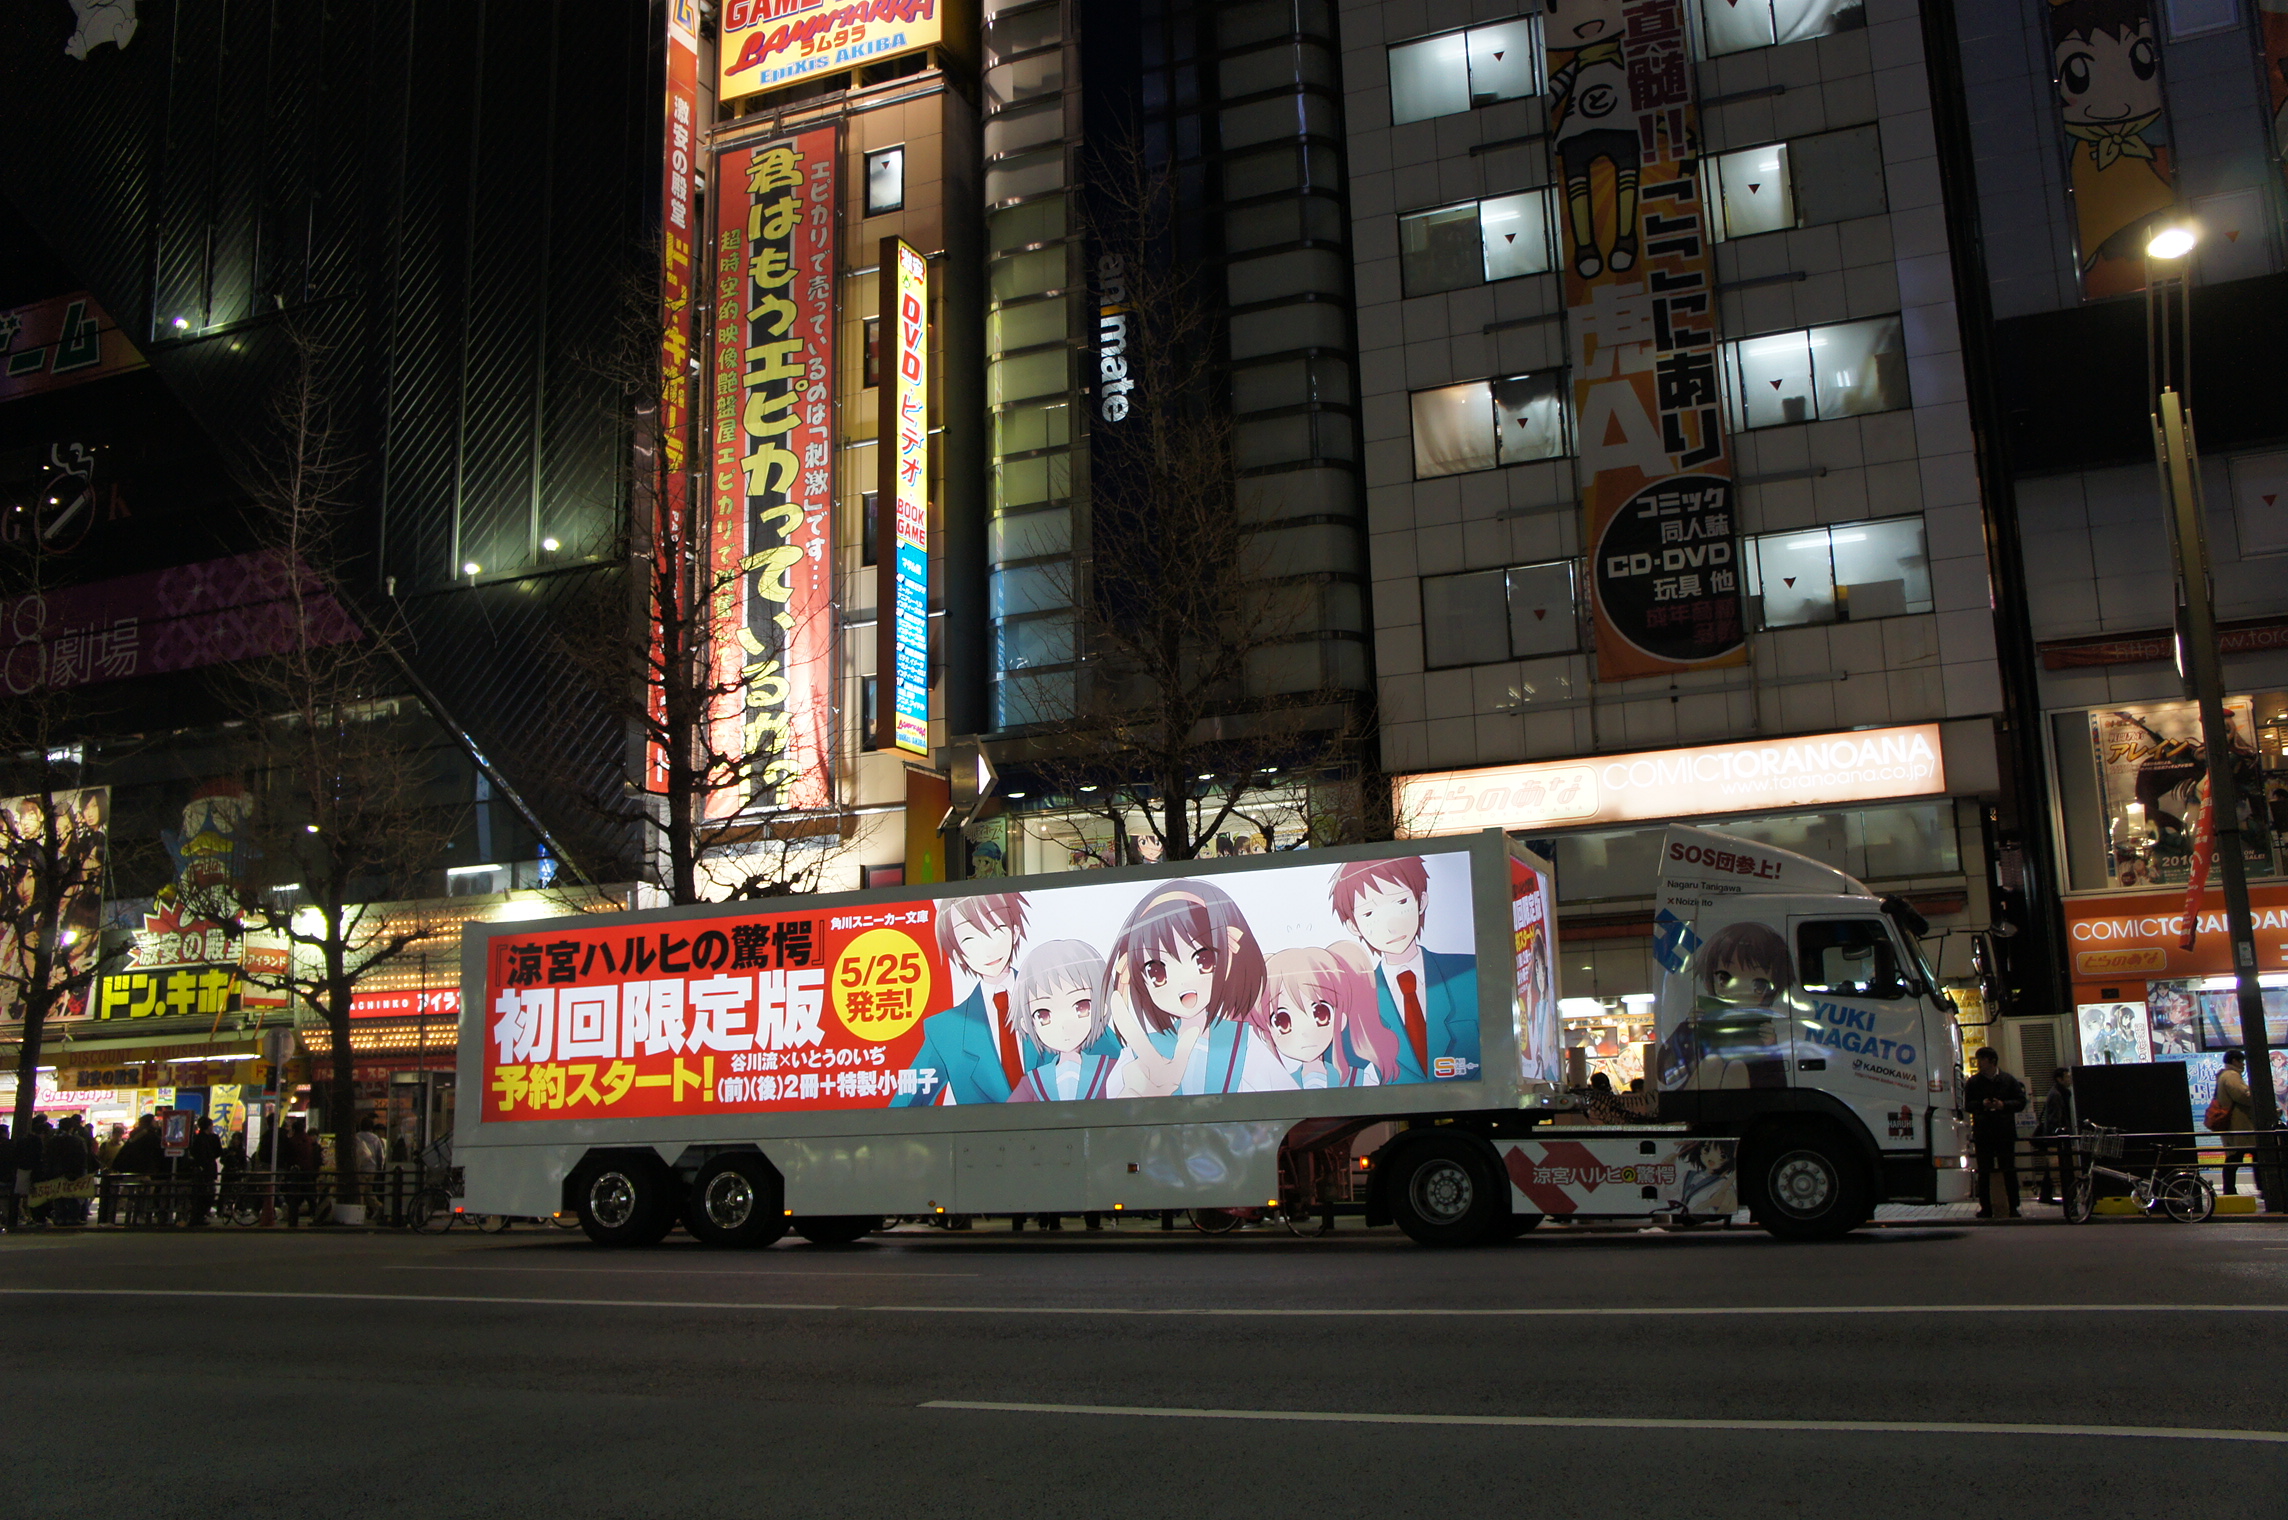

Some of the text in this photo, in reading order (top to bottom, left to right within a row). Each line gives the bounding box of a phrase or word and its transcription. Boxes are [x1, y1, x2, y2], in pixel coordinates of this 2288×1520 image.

[800, 25, 866, 57] ラムタラ
[760, 32, 907, 84] EpiXis AKIBA
[670, 95, 690, 229] 激安の殿堂
[1099, 253, 1138, 423] animate
[1640, 178, 1725, 470] ここにあり
[897, 498, 925, 526] BOOK
[1636, 488, 1725, 519] コミック
[897, 519, 925, 546] GAME
[1660, 513, 1730, 545] 同人誌
[1653, 568, 1736, 602] 玩具 他
[0, 594, 140, 694] 8劇場
[1602, 734, 1934, 791] COMICTORANOANA
[1720, 760, 1935, 796] www.toranoana.co.jp/
[1415, 774, 1582, 817] とらのあな
[1669, 842, 1782, 879] SOS団参上!
[1667, 880, 1741, 893] Nagaru Tanigawa
[1701, 898, 1713, 907] Ito
[830, 909, 929, 931] 角川スニーカー文庫
[246, 953, 287, 967] アイランド
[496, 919, 826, 986] 『涼宮ハルヒの驚愕』
[2084, 951, 2159, 968] とらのあな
[840, 953, 922, 986] 5/25
[350, 992, 460, 1012] ACHINKO アイラ
[494, 968, 826, 1065] 初回限定版
[846, 990, 913, 1023] 発売!
[1812, 1000, 1876, 1032] YUKI
[69, 1042, 234, 1066] DISCOUNT AMUSEMENT
[731, 1046, 886, 1072] 谷川流×いとうのいぢ
[1804, 1027, 1917, 1065] NAGATO
[492, 1056, 714, 1112] 予約スタート!
[1863, 1063, 1917, 1082] KADOKAWA
[42, 1089, 115, 1102] Crazy Crepes
[1532, 1165, 1676, 1186] 涼宮ハルヒの驚愕
